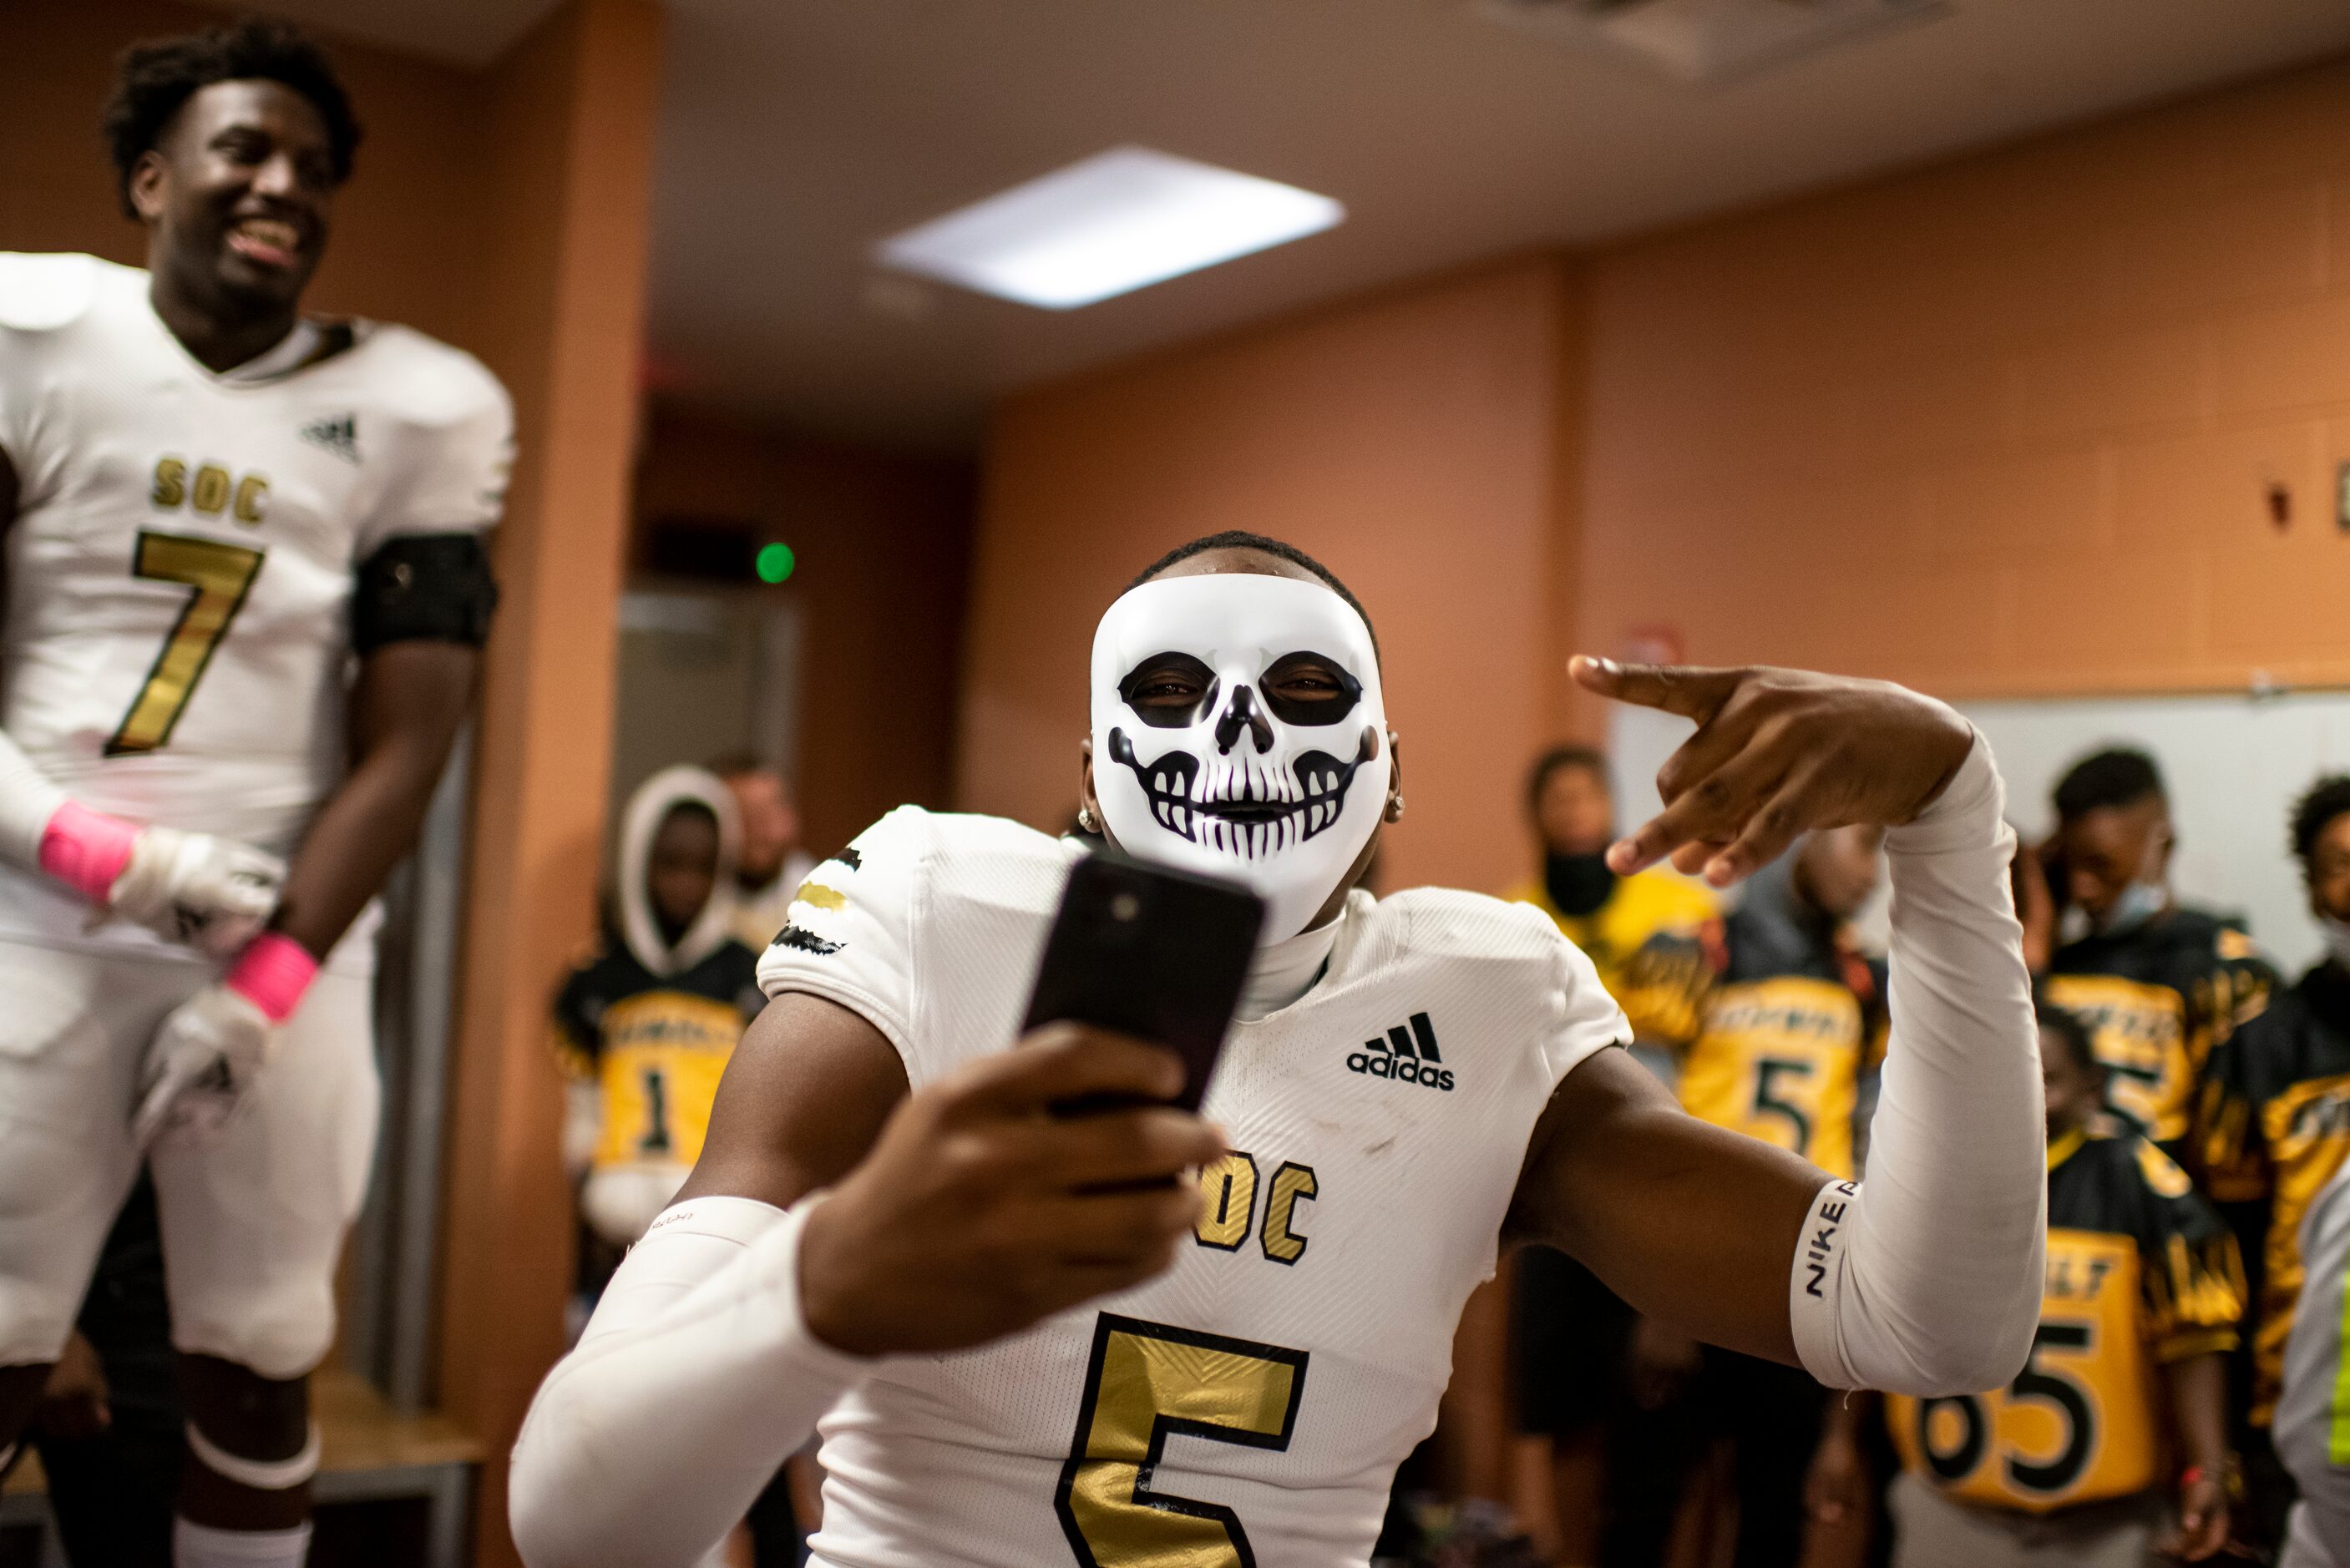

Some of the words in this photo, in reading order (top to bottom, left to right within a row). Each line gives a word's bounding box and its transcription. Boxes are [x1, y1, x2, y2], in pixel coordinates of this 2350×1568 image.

[152, 458, 269, 524] SOC
[104, 530, 265, 757] 7
[640, 1068, 670, 1152] 1
[1346, 1052, 1455, 1091] adidas
[1755, 1055, 1814, 1159] 5
[1193, 1149, 1319, 1267] OC
[1806, 1202, 1847, 1298] NIKE
[1054, 1311, 1309, 1568] 5
